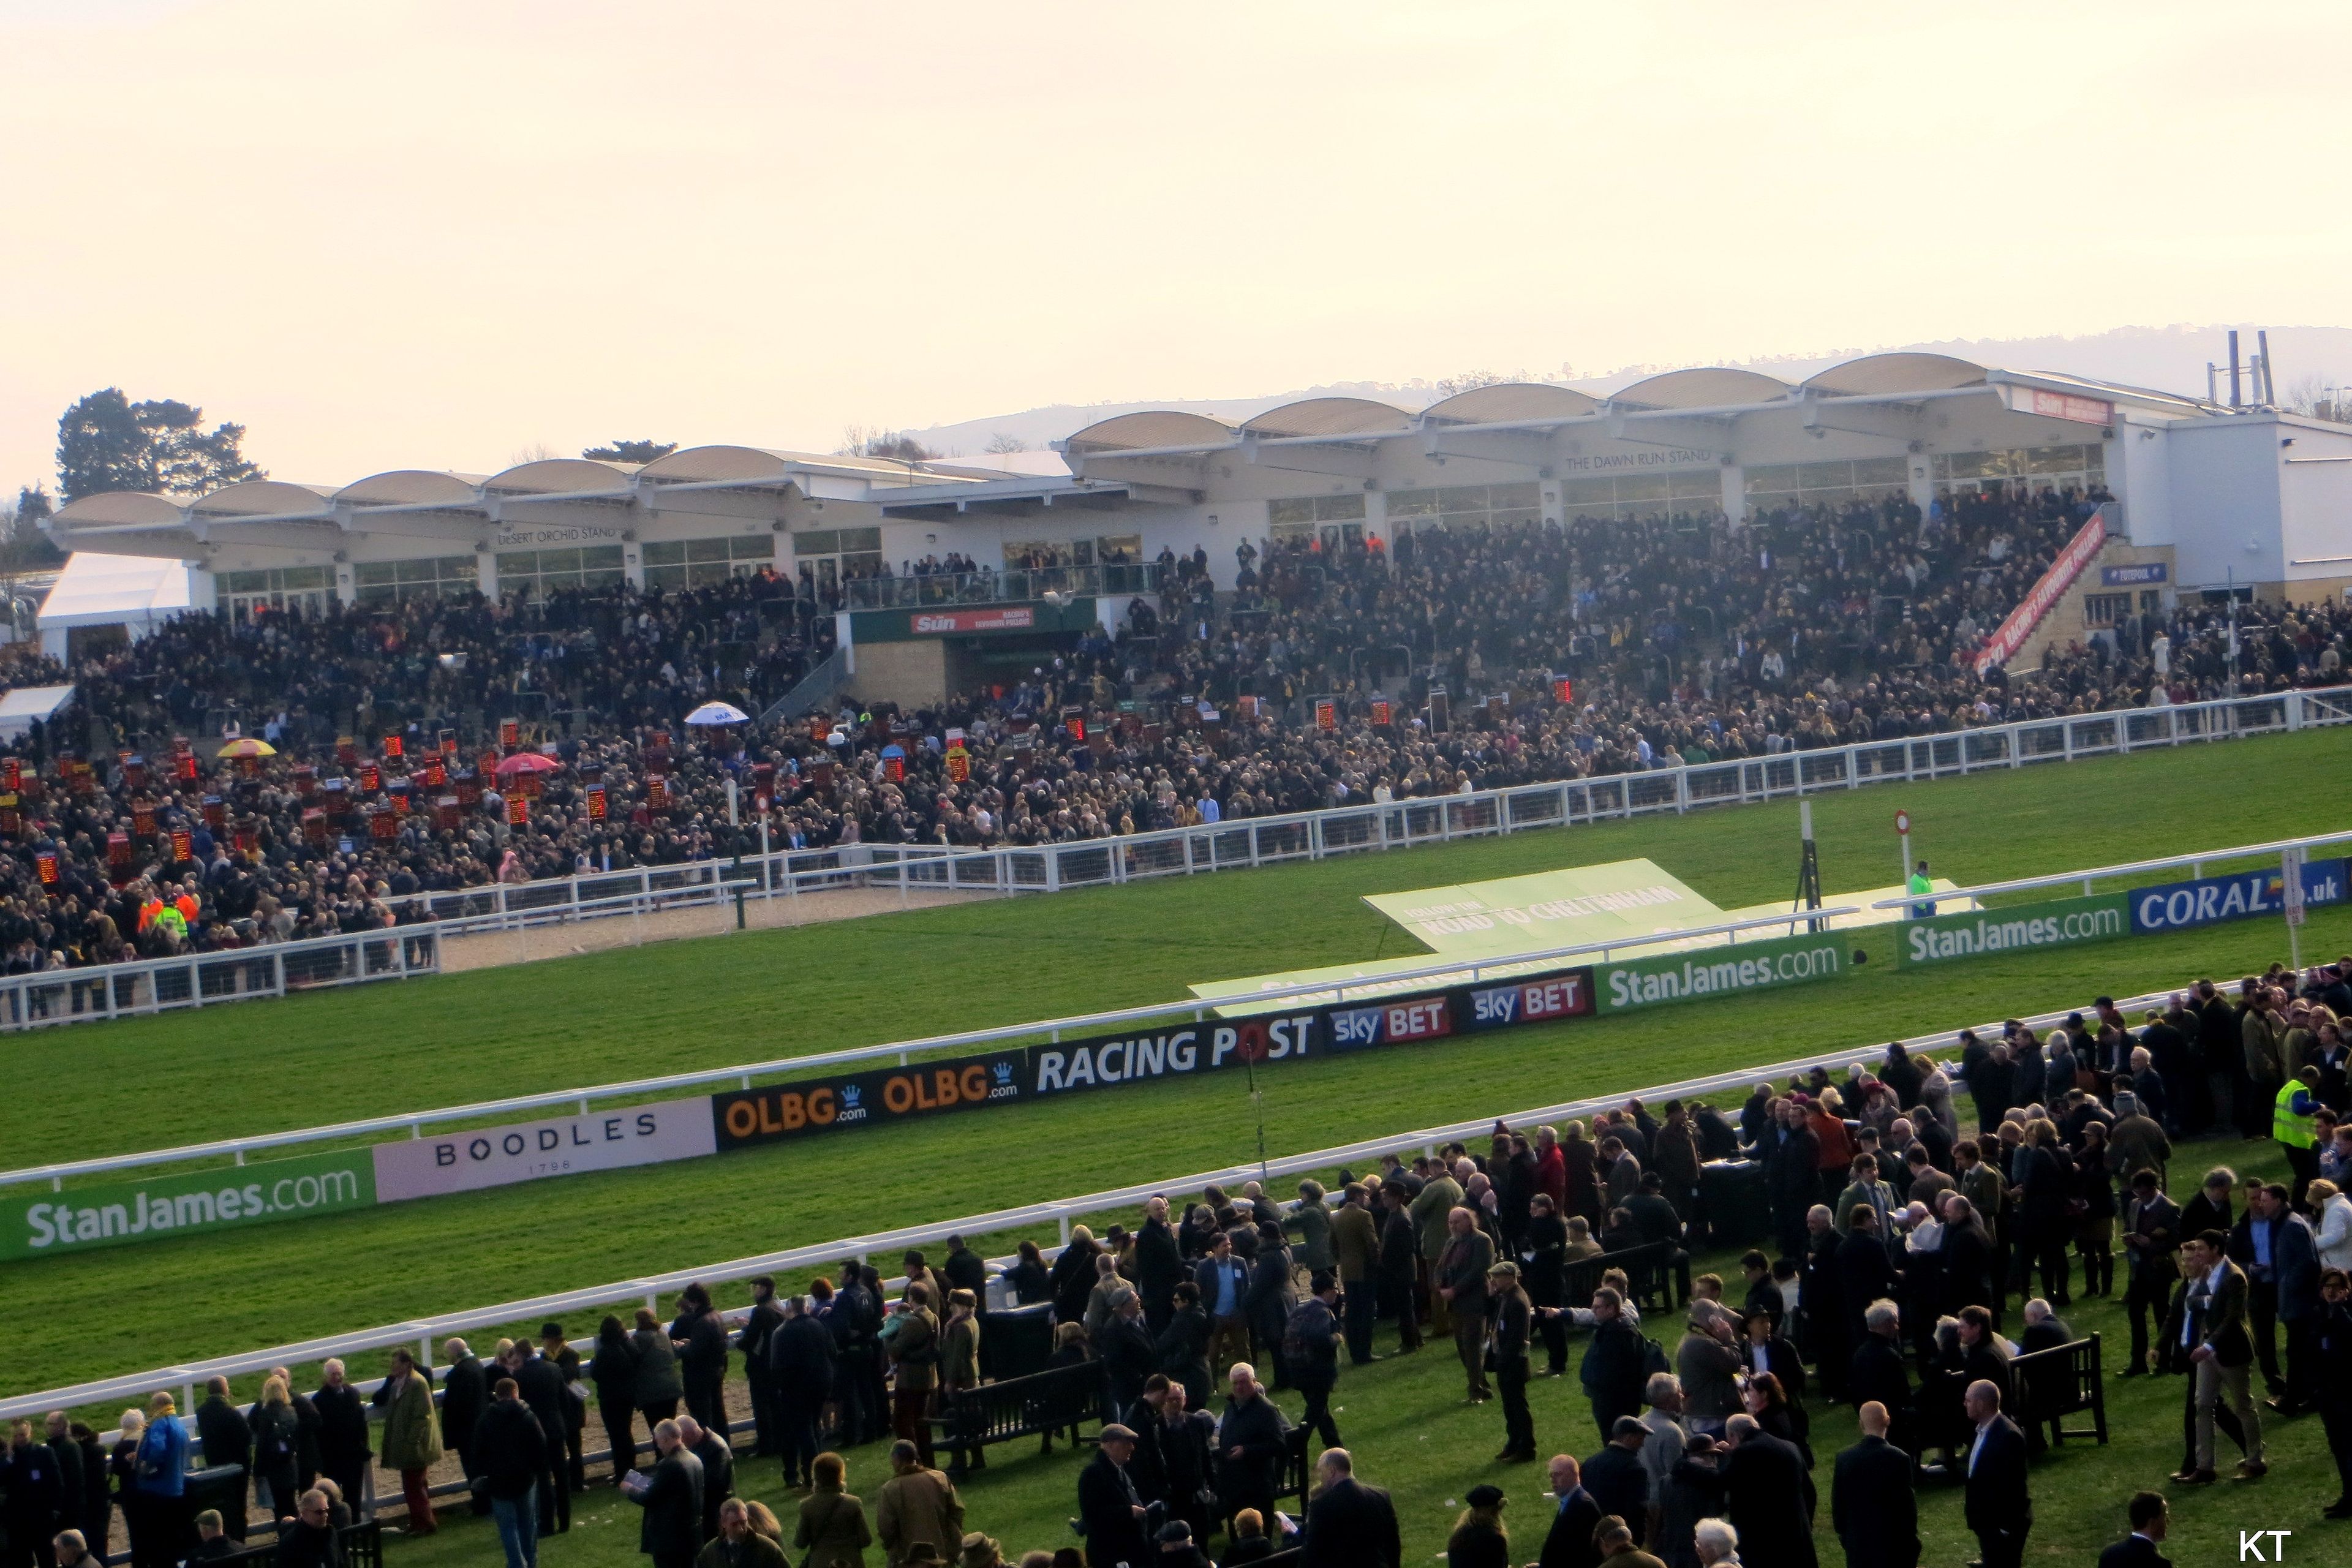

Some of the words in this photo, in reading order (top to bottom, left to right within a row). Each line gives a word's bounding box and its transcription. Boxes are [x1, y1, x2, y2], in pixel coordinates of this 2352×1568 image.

[1566, 457, 1589, 470] THE
[1593, 454, 1634, 468] DAWN
[1638, 453, 1665, 465] RUN
[1669, 450, 1711, 464] STAND
[537, 529, 579, 543] ORCHID
[581, 527, 615, 540] STAND
[917, 616, 956, 632] Sun
[1909, 907, 2120, 961] StanJames.com
[1609, 946, 1838, 1007] StanJames.com
[1476, 990, 1517, 1022] sky
[1525, 981, 1578, 1014] BET
[1335, 1012, 1379, 1044] sky
[1388, 1003, 1444, 1037] BET
[1038, 1031, 1196, 1091] RACING
[1212, 1016, 1314, 1066] POST
[435, 1113, 657, 1166] BOODLES
[529, 1159, 571, 1175] 1798
[26, 1170, 359, 1248] StanJames.com
